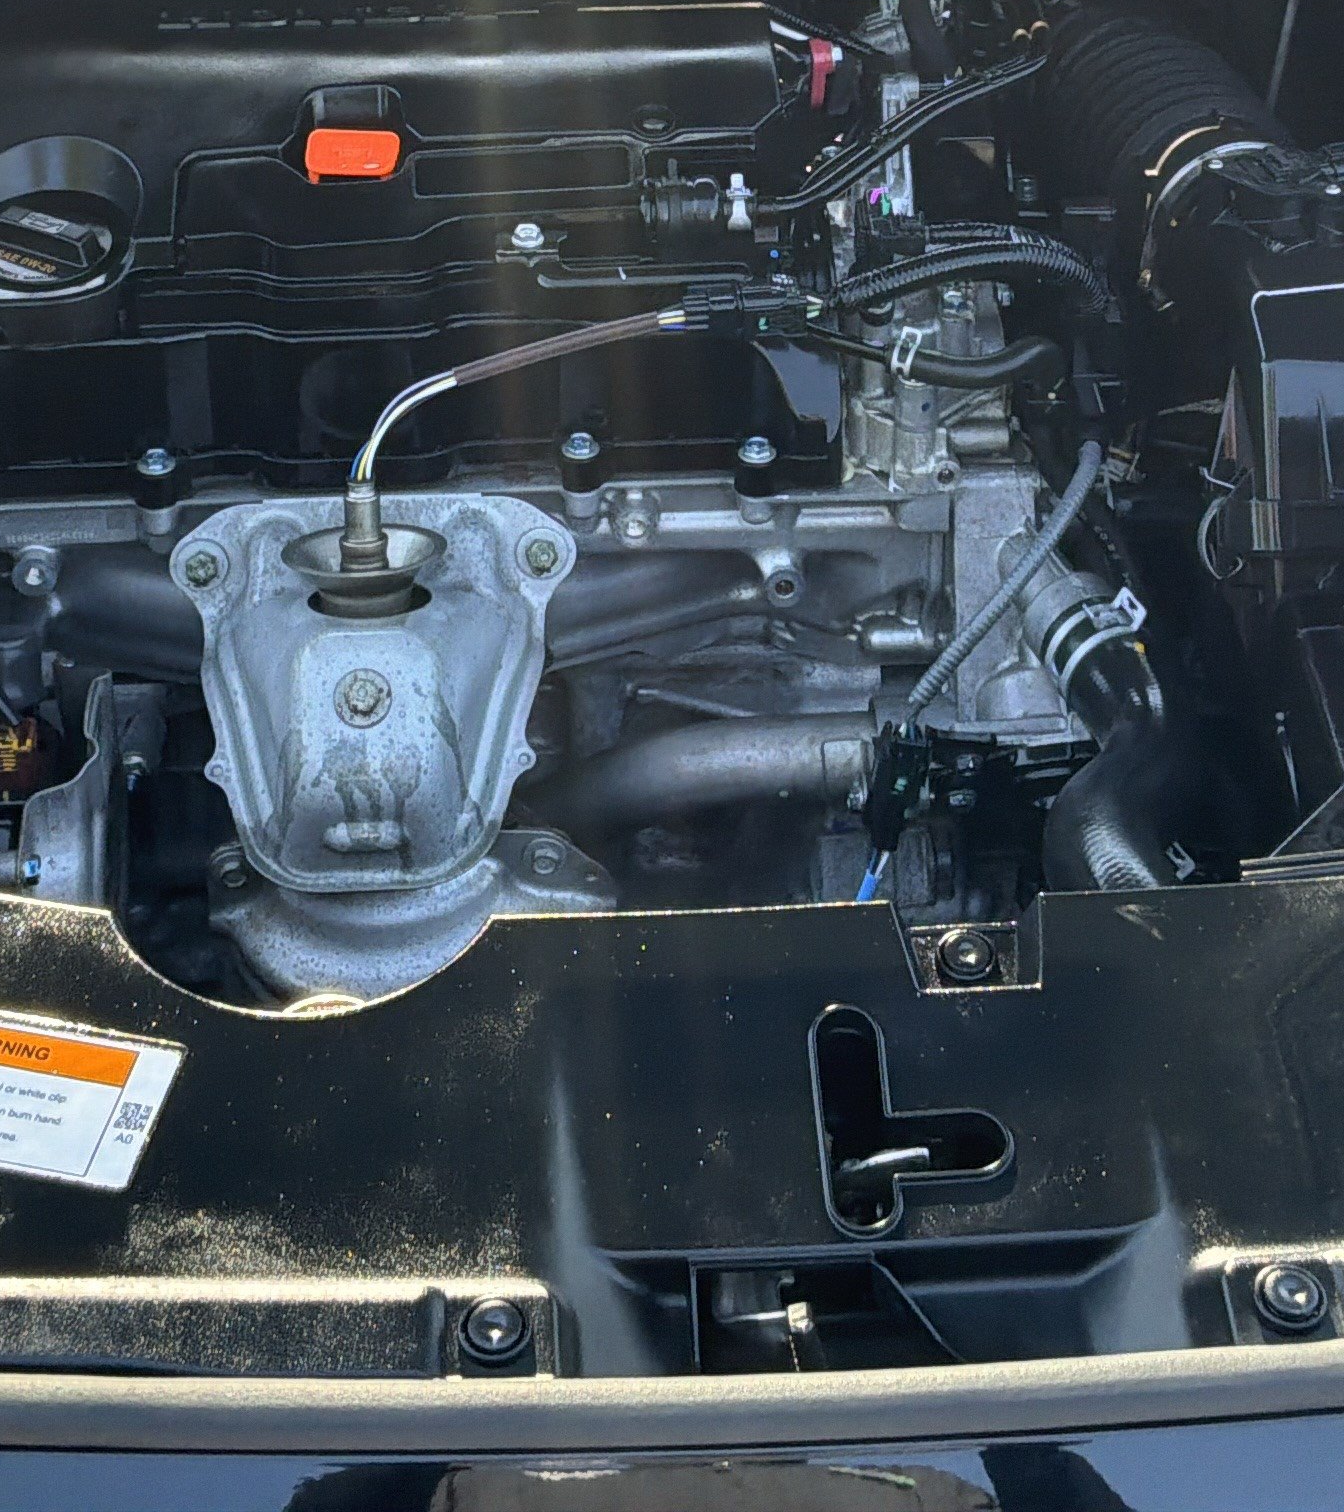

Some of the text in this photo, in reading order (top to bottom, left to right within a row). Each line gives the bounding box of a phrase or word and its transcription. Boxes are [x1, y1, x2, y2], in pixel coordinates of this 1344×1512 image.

[5, 1086, 17, 1094] or
[19, 1088, 46, 1100] white
[8, 1108, 33, 1121] burn
[114, 1132, 134, 1144] A0
